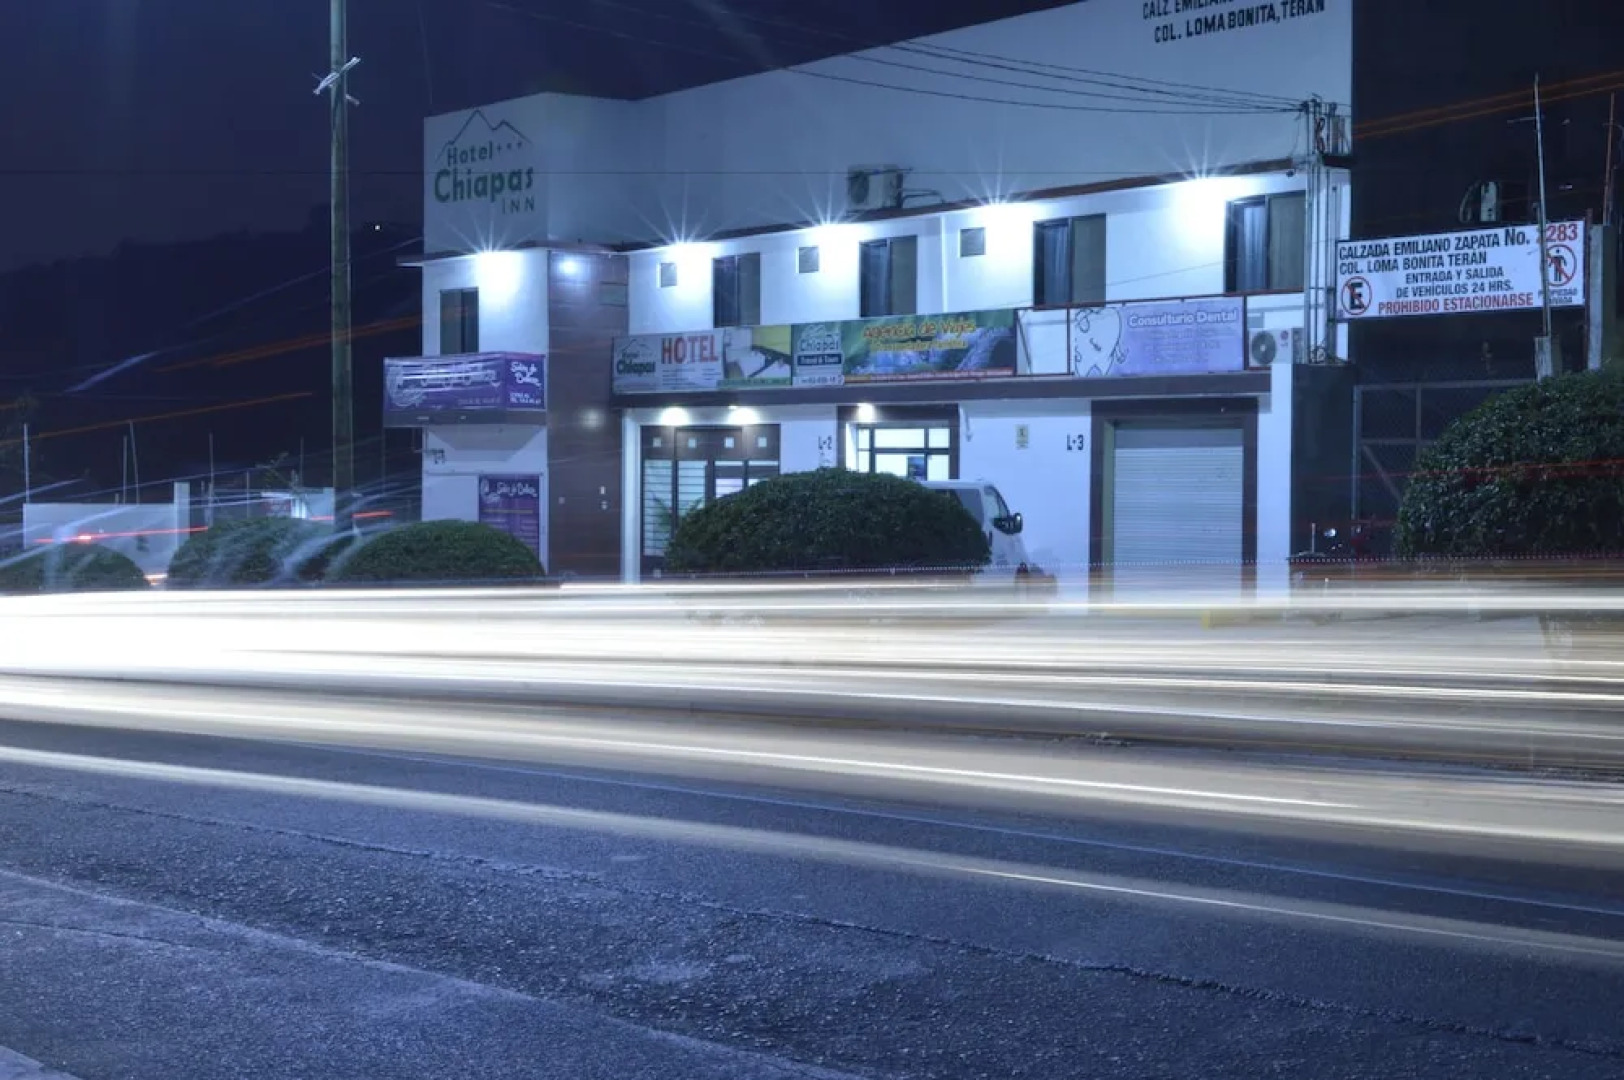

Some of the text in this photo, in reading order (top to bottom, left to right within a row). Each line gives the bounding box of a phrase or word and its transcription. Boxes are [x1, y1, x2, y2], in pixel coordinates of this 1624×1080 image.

[1175, 0, 1234, 13] EMIL
[1154, 23, 1182, 43] COL.
[1186, 13, 1225, 37] LOMA
[1228, 3, 1280, 29] BONITA,
[447, 141, 493, 166] Hotel
[434, 167, 534, 203] Chiapas
[502, 196, 535, 214] INN
[1339, 223, 1578, 260] CALZADA EMILIANO ZAPATA No. 283
[1339, 262, 1363, 275] COL.
[1367, 258, 1399, 273] LOMA
[1403, 254, 1445, 270] BONITA
[1405, 266, 1504, 285] ENTRADA Y SALIDA
[1396, 287, 1409, 299] DE
[1472, 282, 1485, 294] 24
[1489, 279, 1514, 292] HRS.
[1378, 292, 1533, 315] PROHIBIDO ESTACIONARSE
[1196, 308, 1239, 324] Dental
[661, 334, 719, 364] HOTEL
